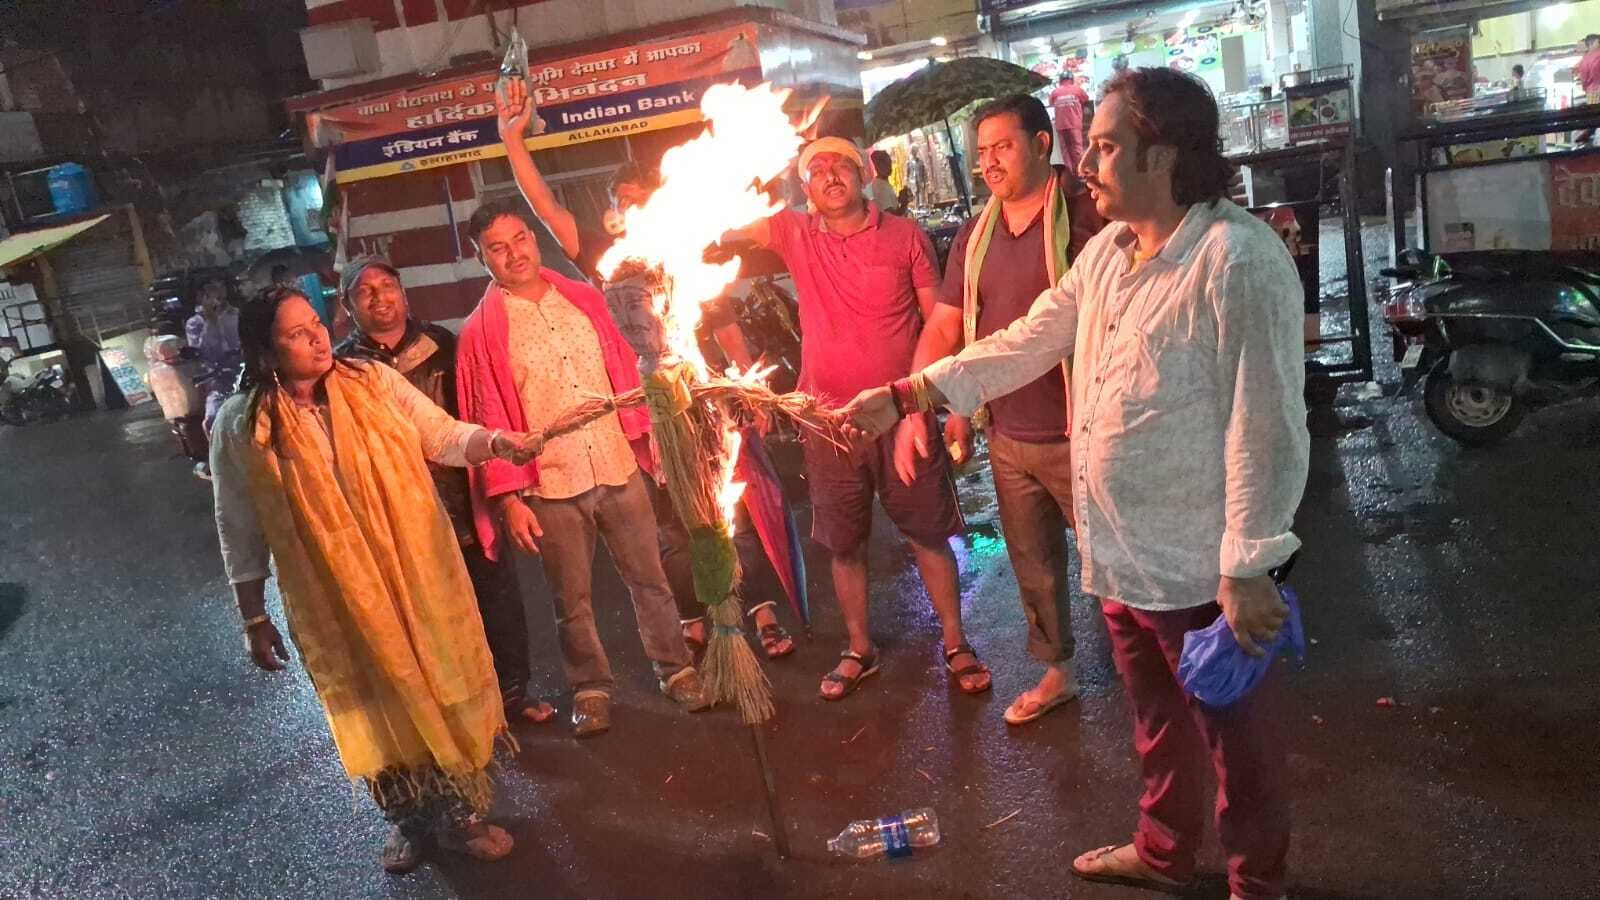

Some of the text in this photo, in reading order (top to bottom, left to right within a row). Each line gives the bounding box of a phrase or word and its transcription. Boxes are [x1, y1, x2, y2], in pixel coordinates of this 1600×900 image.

[459, 83, 476, 97] के
[623, 51, 639, 66] में
[647, 42, 702, 62] आपका
[406, 73, 647, 129] हार्दिक भिनंदन
[561, 91, 696, 125] Indian Bank
[382, 129, 480, 158] इंडियन बैंक
[567, 121, 649, 142] ALLAHABAD
